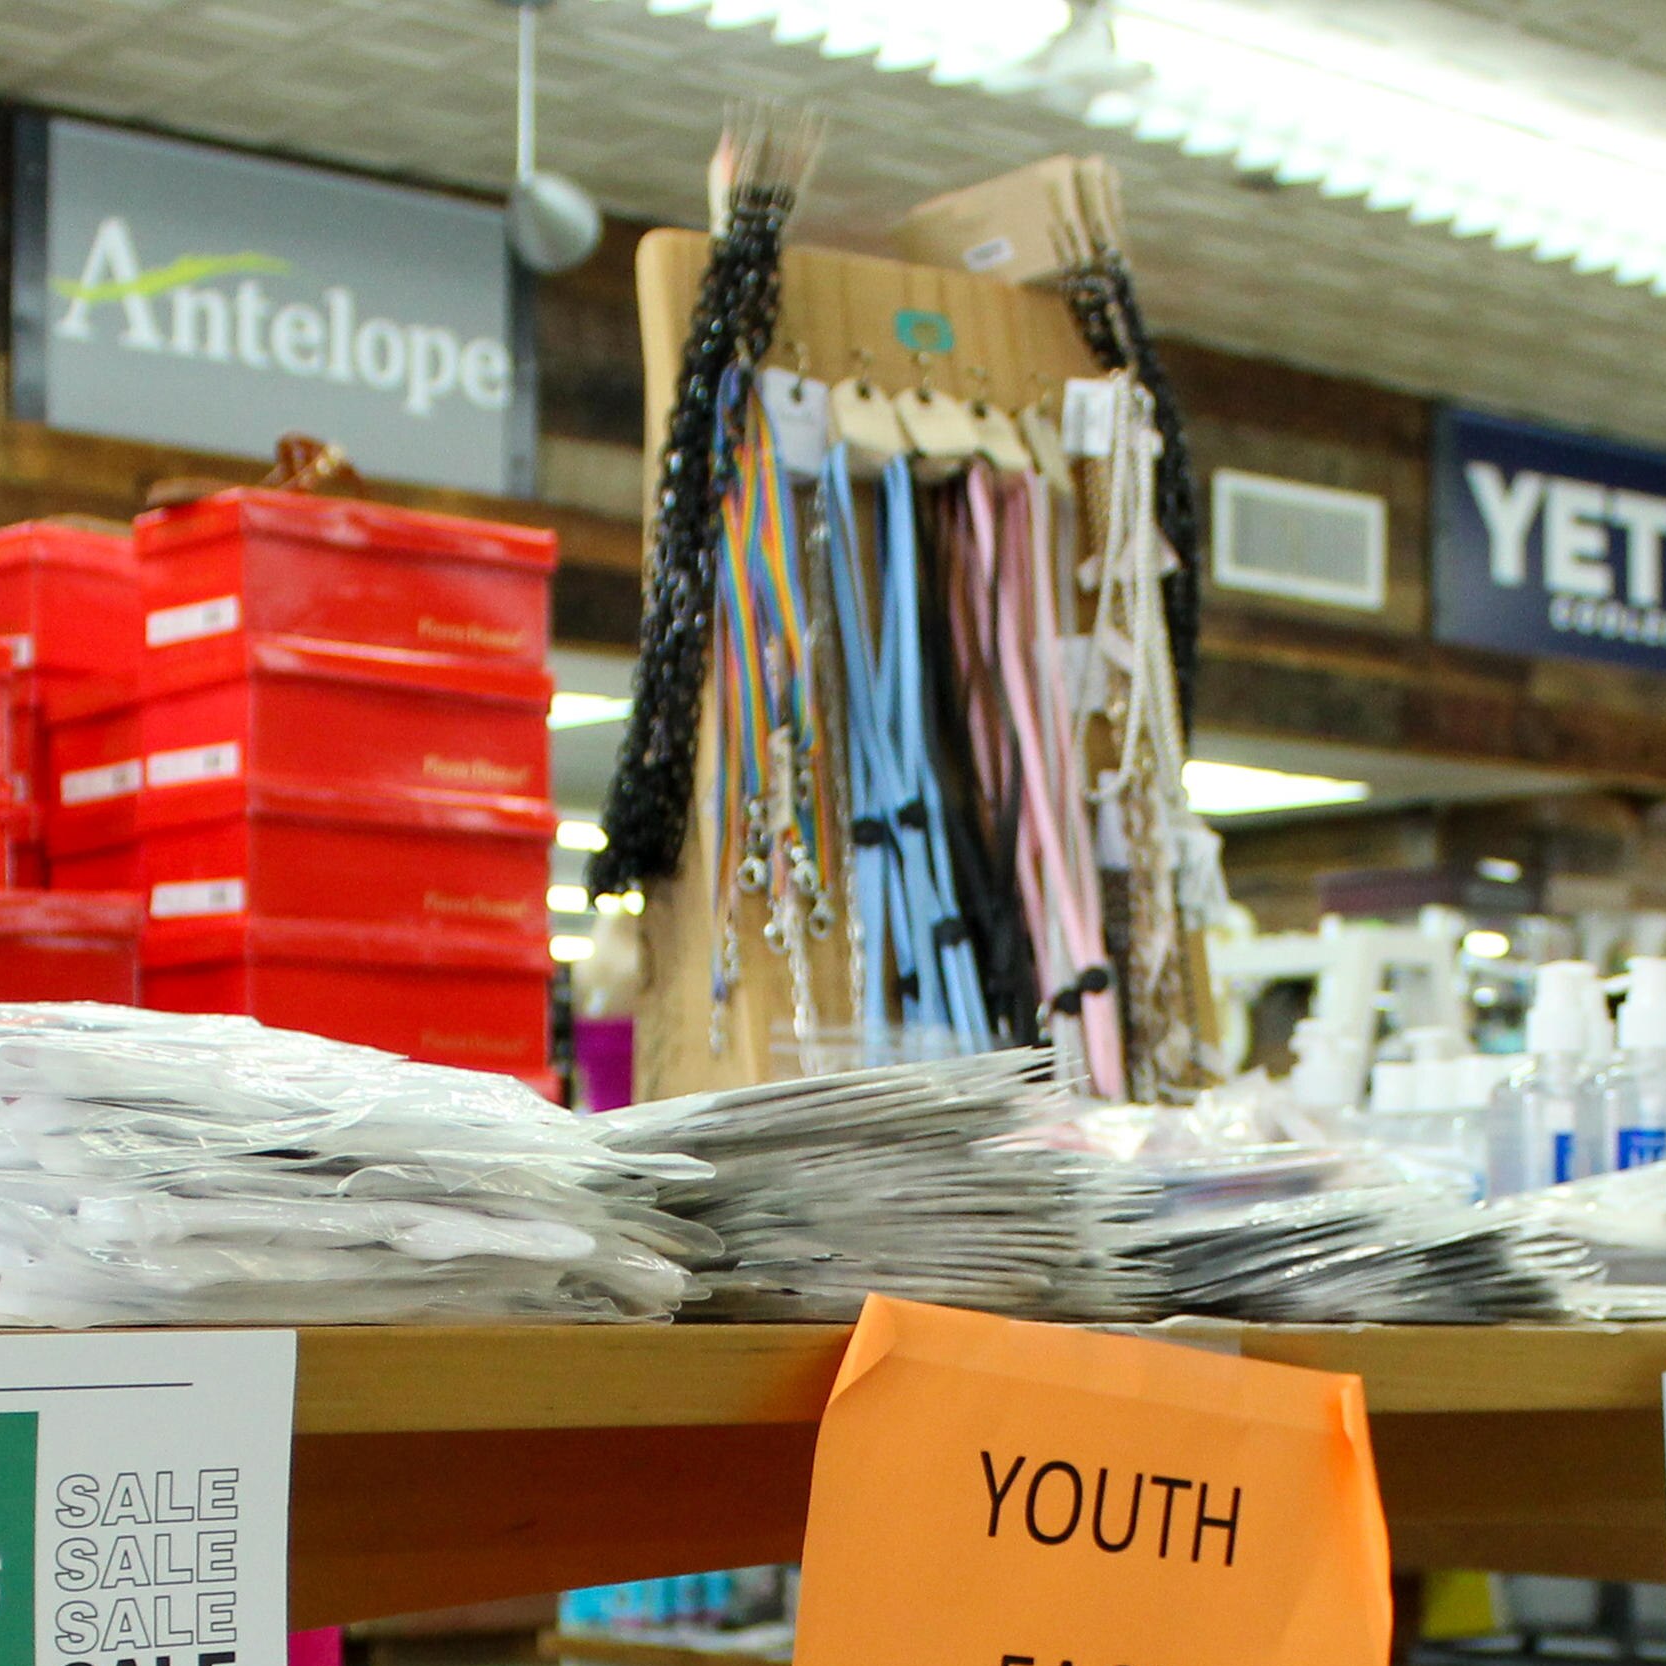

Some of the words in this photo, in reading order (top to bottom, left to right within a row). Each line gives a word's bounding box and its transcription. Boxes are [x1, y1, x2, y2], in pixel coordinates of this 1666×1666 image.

[53, 215, 513, 416] Antelope
[55, 1468, 238, 1528] SALE
[980, 1450, 1242, 1566] YOUTH
[55, 1530, 238, 1590] SALE
[55, 1591, 237, 1653] SALE
